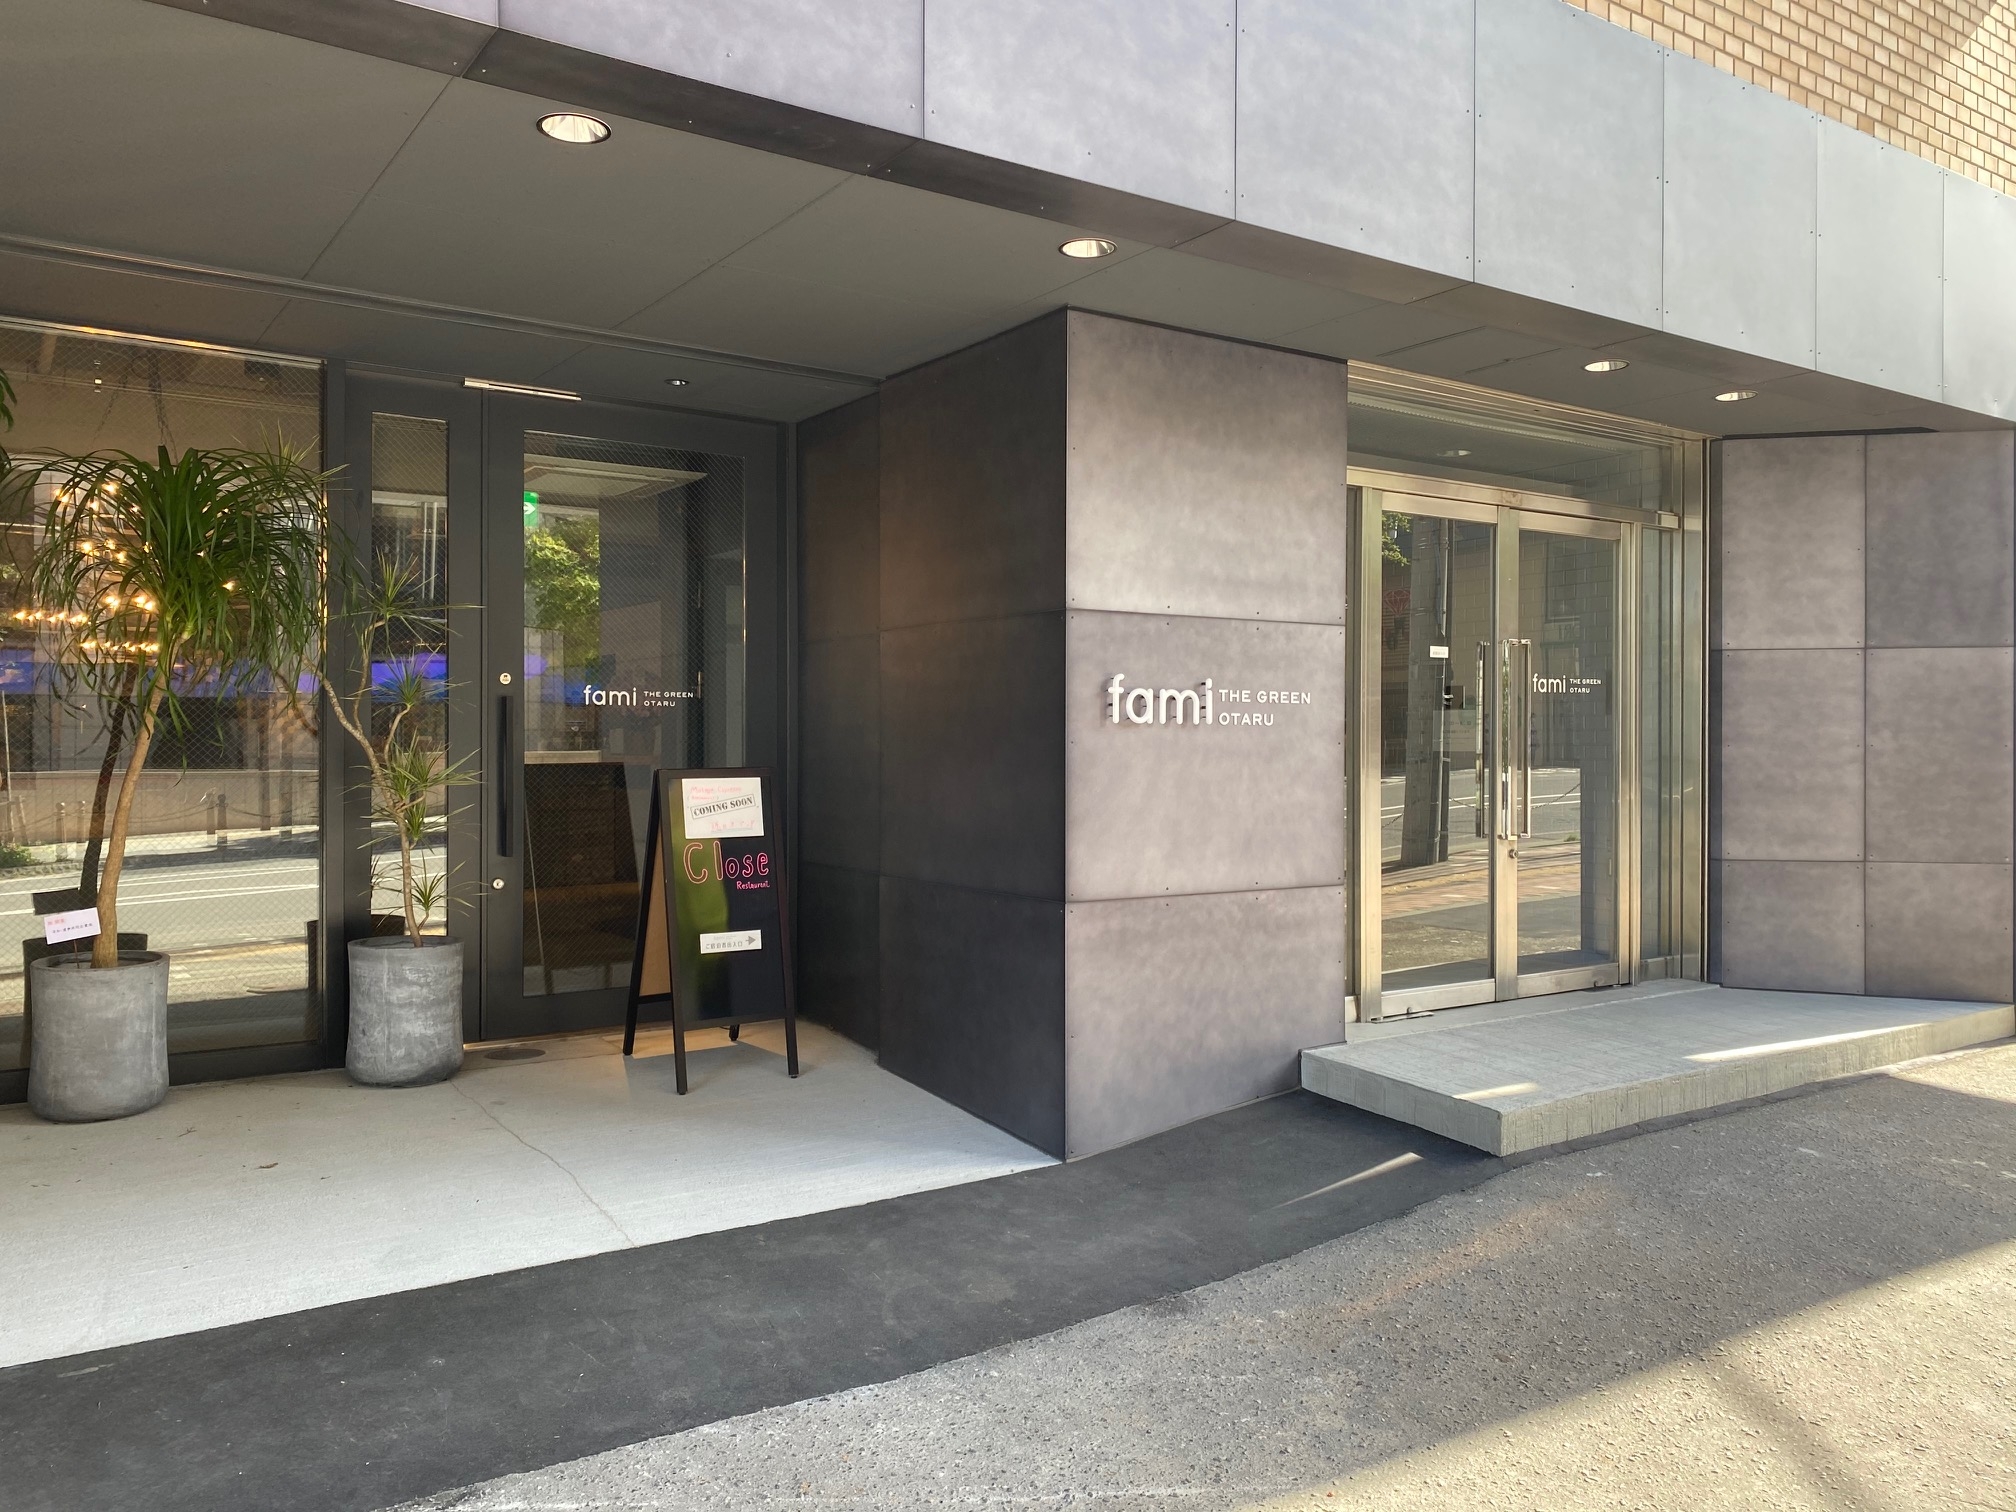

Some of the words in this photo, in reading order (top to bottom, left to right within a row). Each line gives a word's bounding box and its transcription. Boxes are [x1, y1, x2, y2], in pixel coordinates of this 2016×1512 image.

[1532, 673, 1567, 694] fami
[583, 684, 637, 706] fami
[1107, 673, 1213, 725] fami
[1218, 689, 1251, 703] THE
[1256, 690, 1311, 705] GREEN
[1218, 712, 1274, 726] OTARU
[693, 802, 728, 816] COMING
[729, 796, 754, 809] SOON
[683, 840, 770, 884] Close
